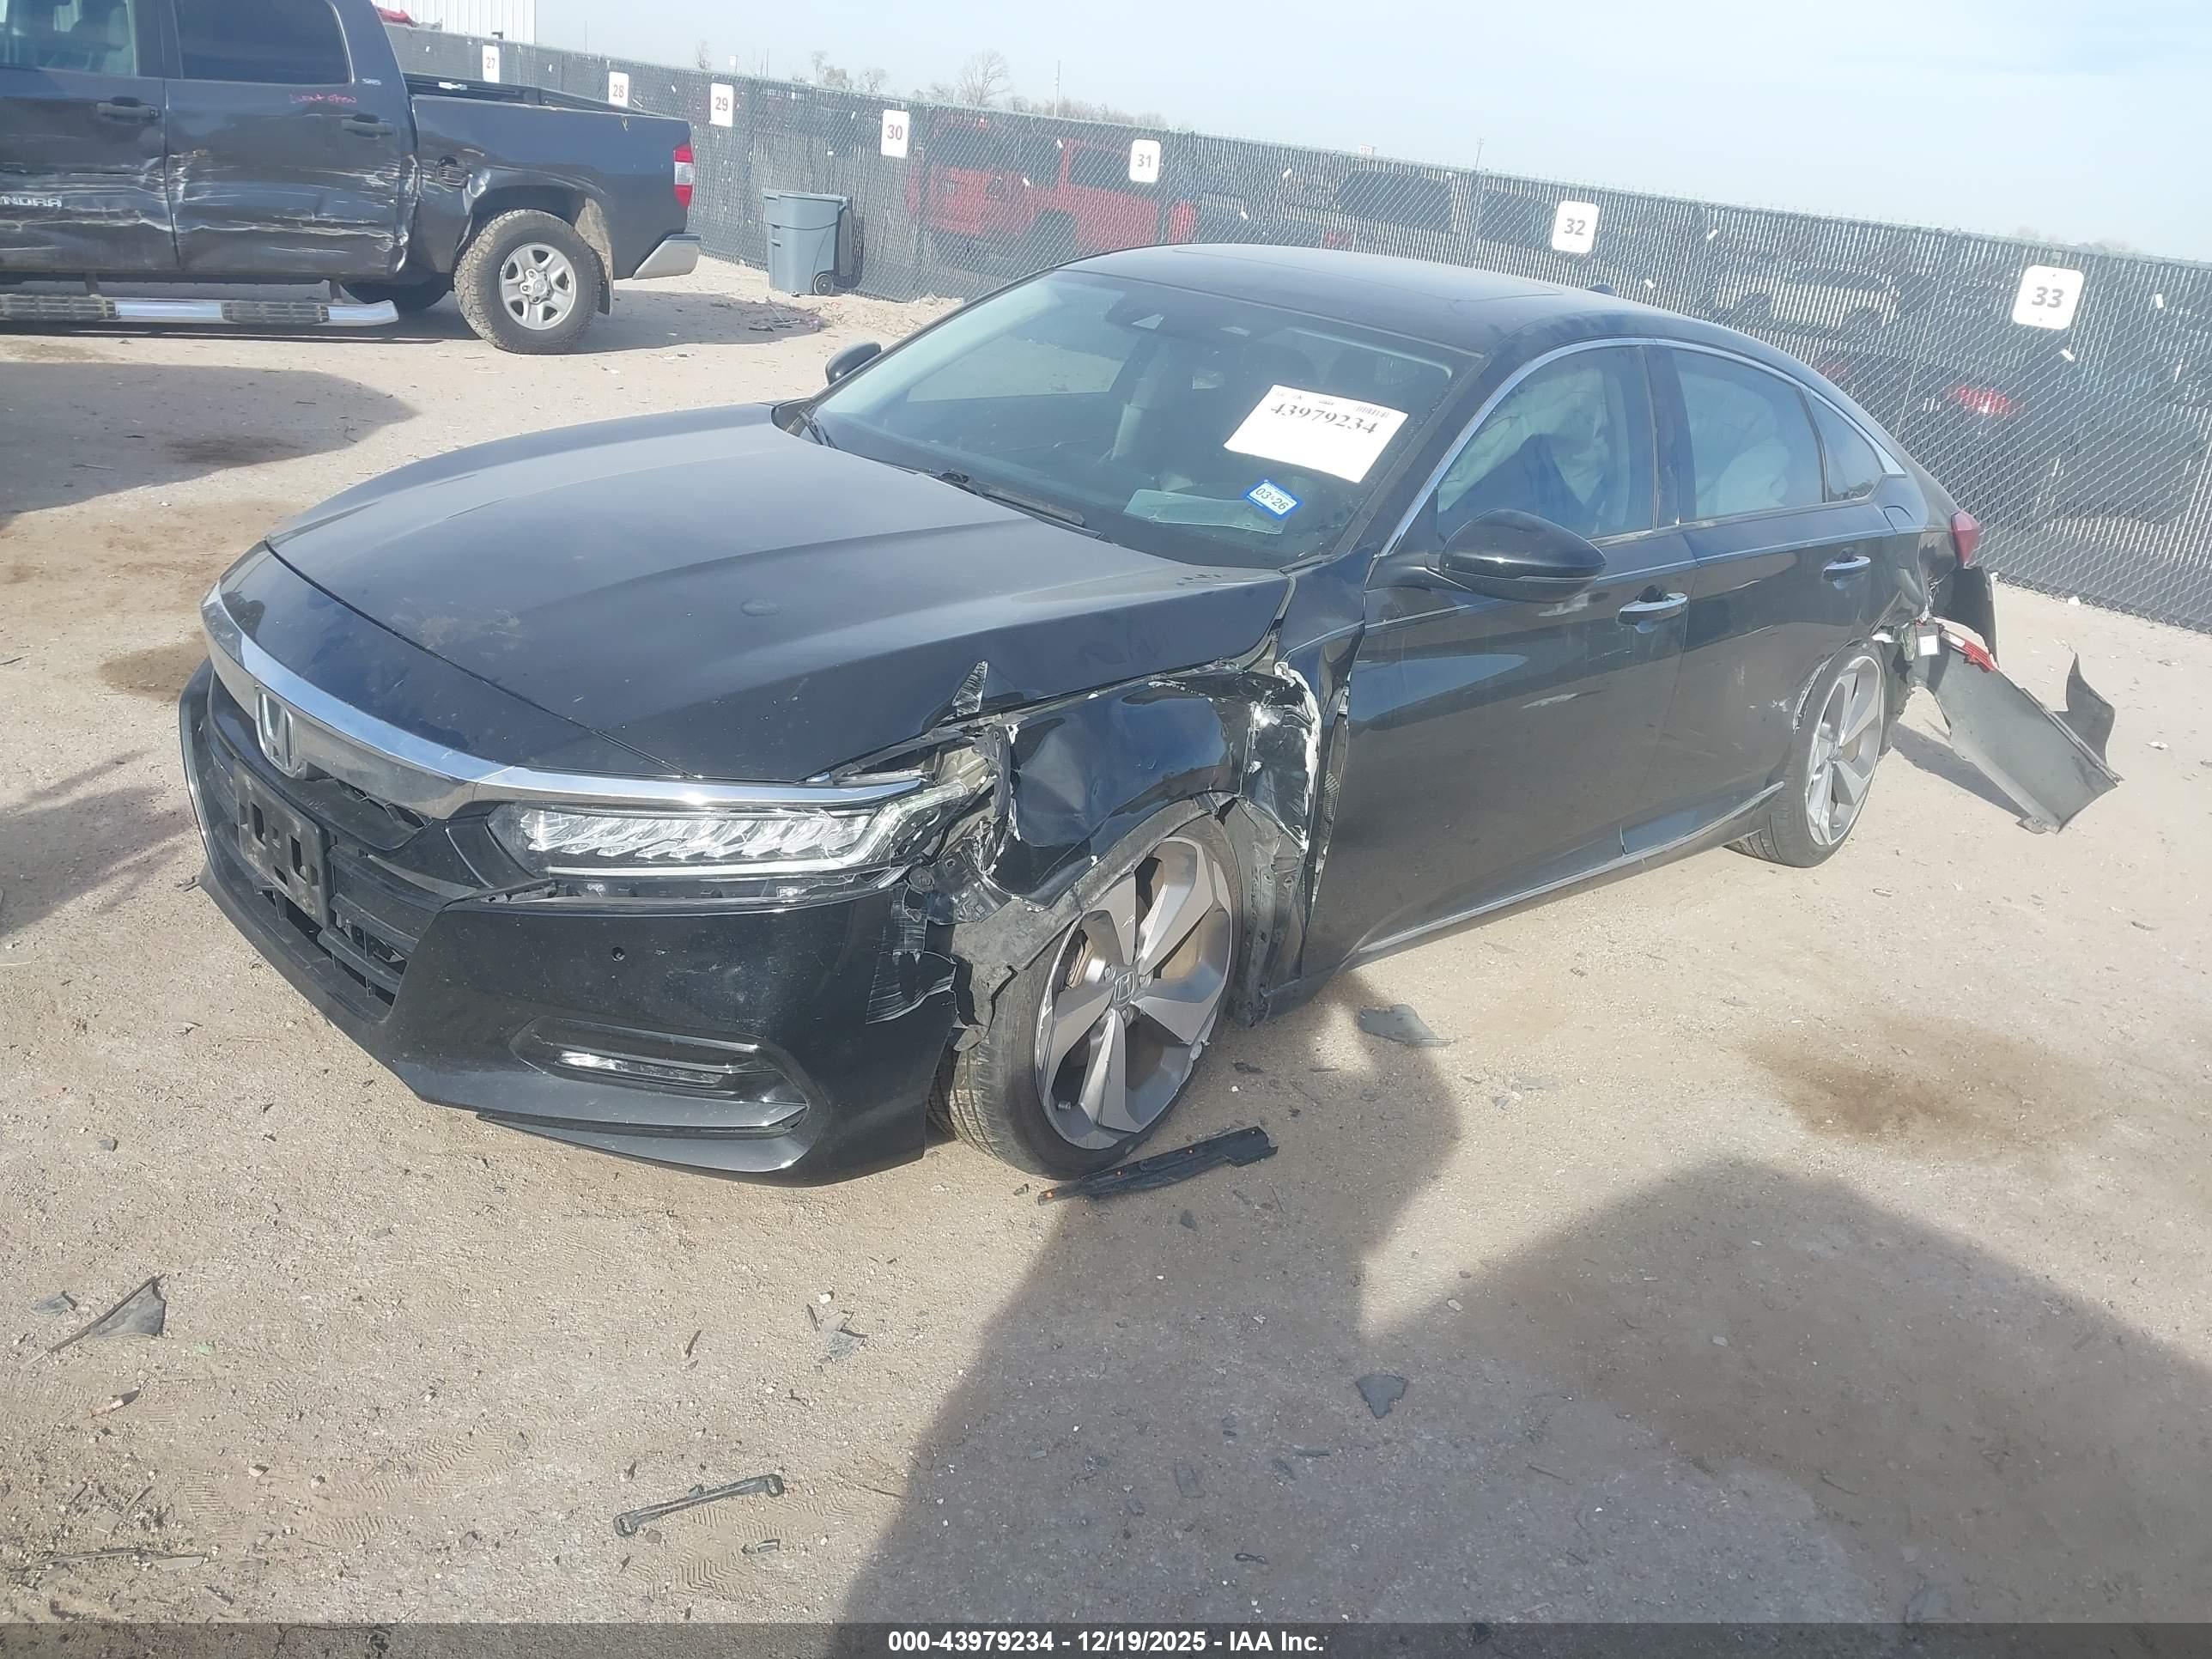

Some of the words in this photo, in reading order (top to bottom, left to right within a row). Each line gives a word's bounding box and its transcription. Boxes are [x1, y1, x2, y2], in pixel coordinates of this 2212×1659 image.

[485, 56, 495, 70] 27
[612, 83, 624, 98] 28
[714, 96, 728, 112] 29
[886, 124, 902, 141] 30
[1137, 154, 1152, 168] 31
[0, 196, 63, 207] NDRA
[1564, 217, 1586, 236] 32
[2031, 285, 2064, 309] 33
[1271, 402, 1378, 434] 43979234
